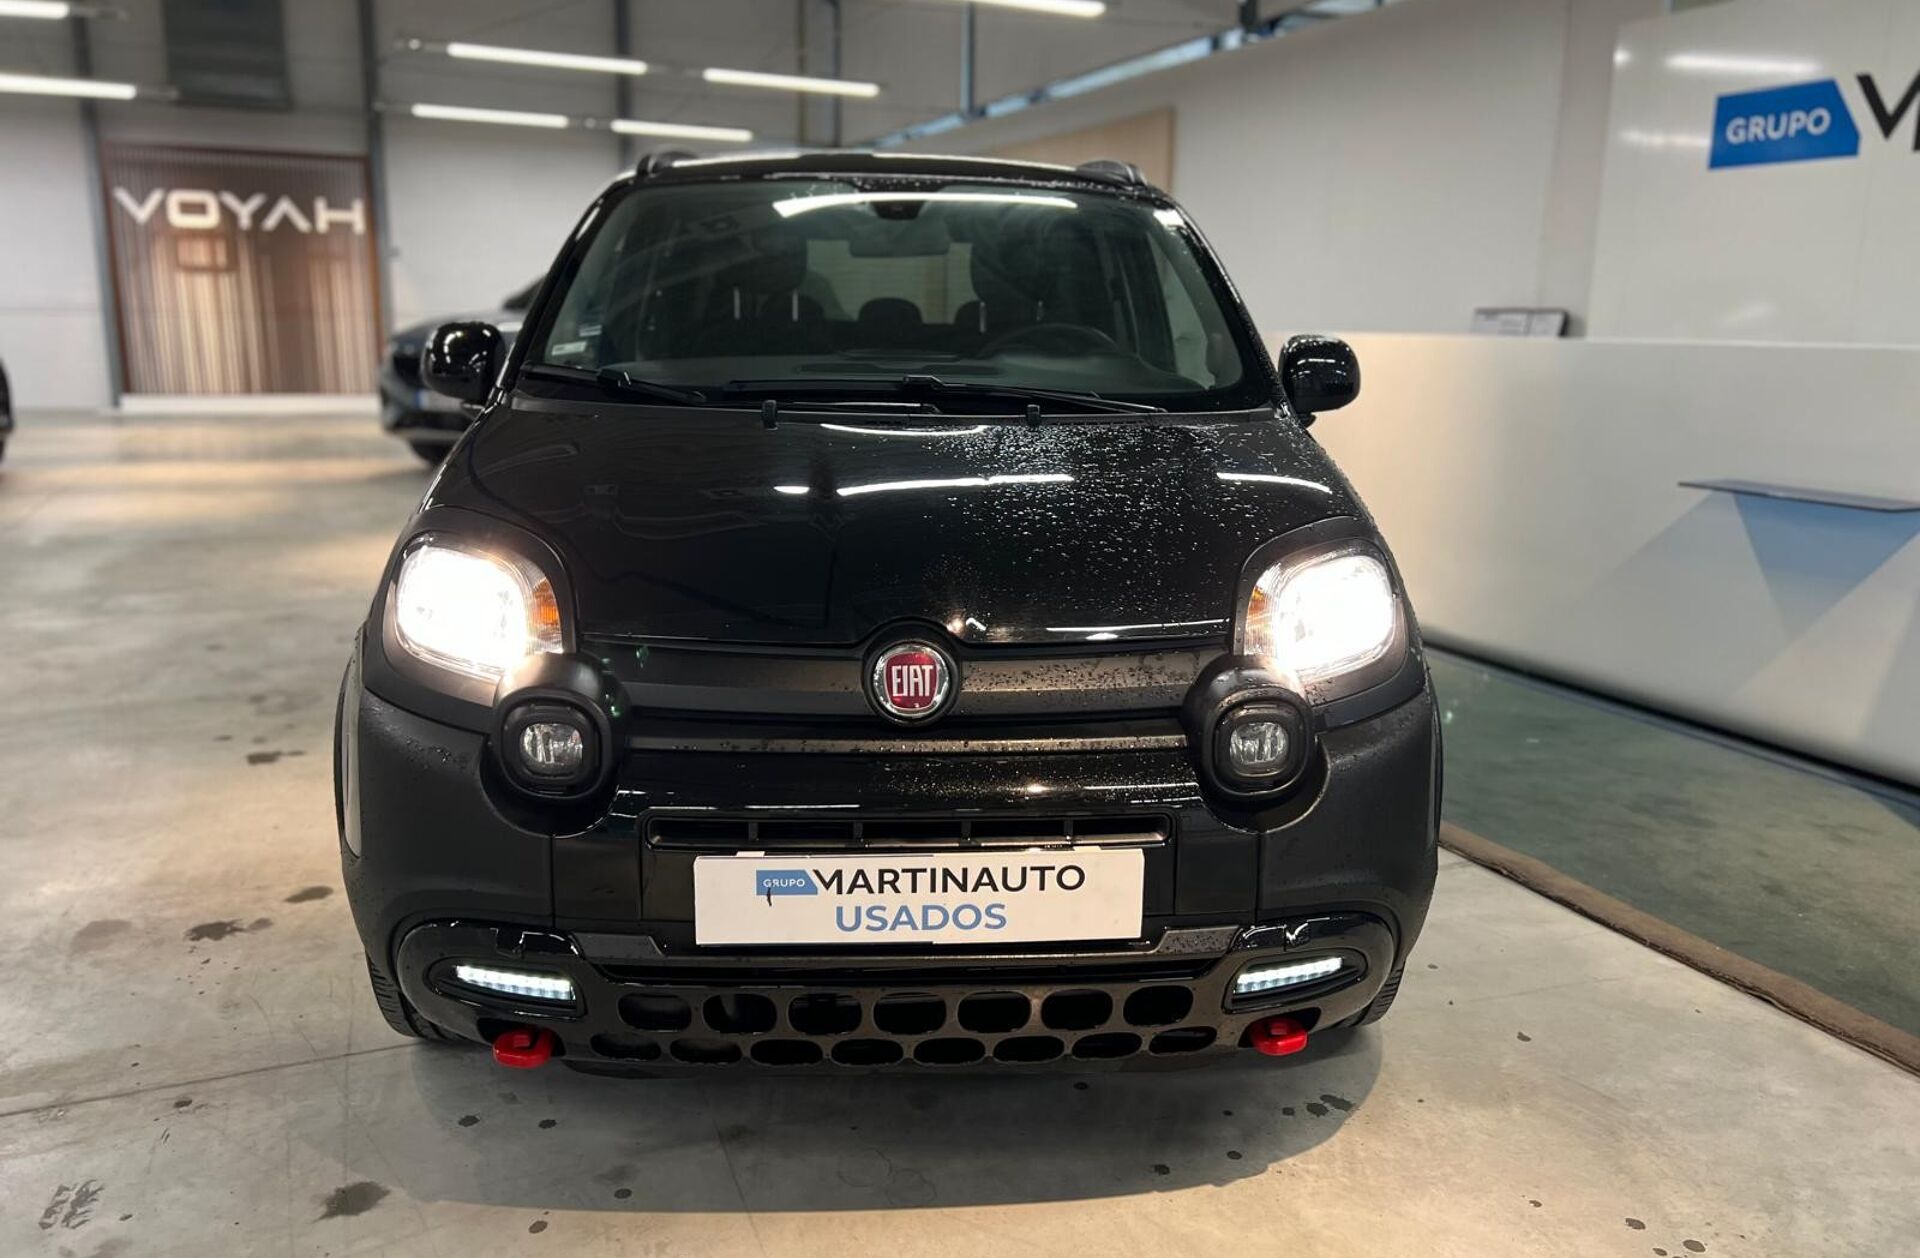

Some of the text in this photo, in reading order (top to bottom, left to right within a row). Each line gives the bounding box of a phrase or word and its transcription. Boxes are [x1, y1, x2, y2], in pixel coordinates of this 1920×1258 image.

[1726, 107, 1831, 144] GRUPO
[113, 187, 366, 234] VOYAH
[891, 664, 933, 697] FIAT
[762, 865, 1086, 895] GRUPO MARTINAUTO
[835, 903, 1007, 932] USADOS
